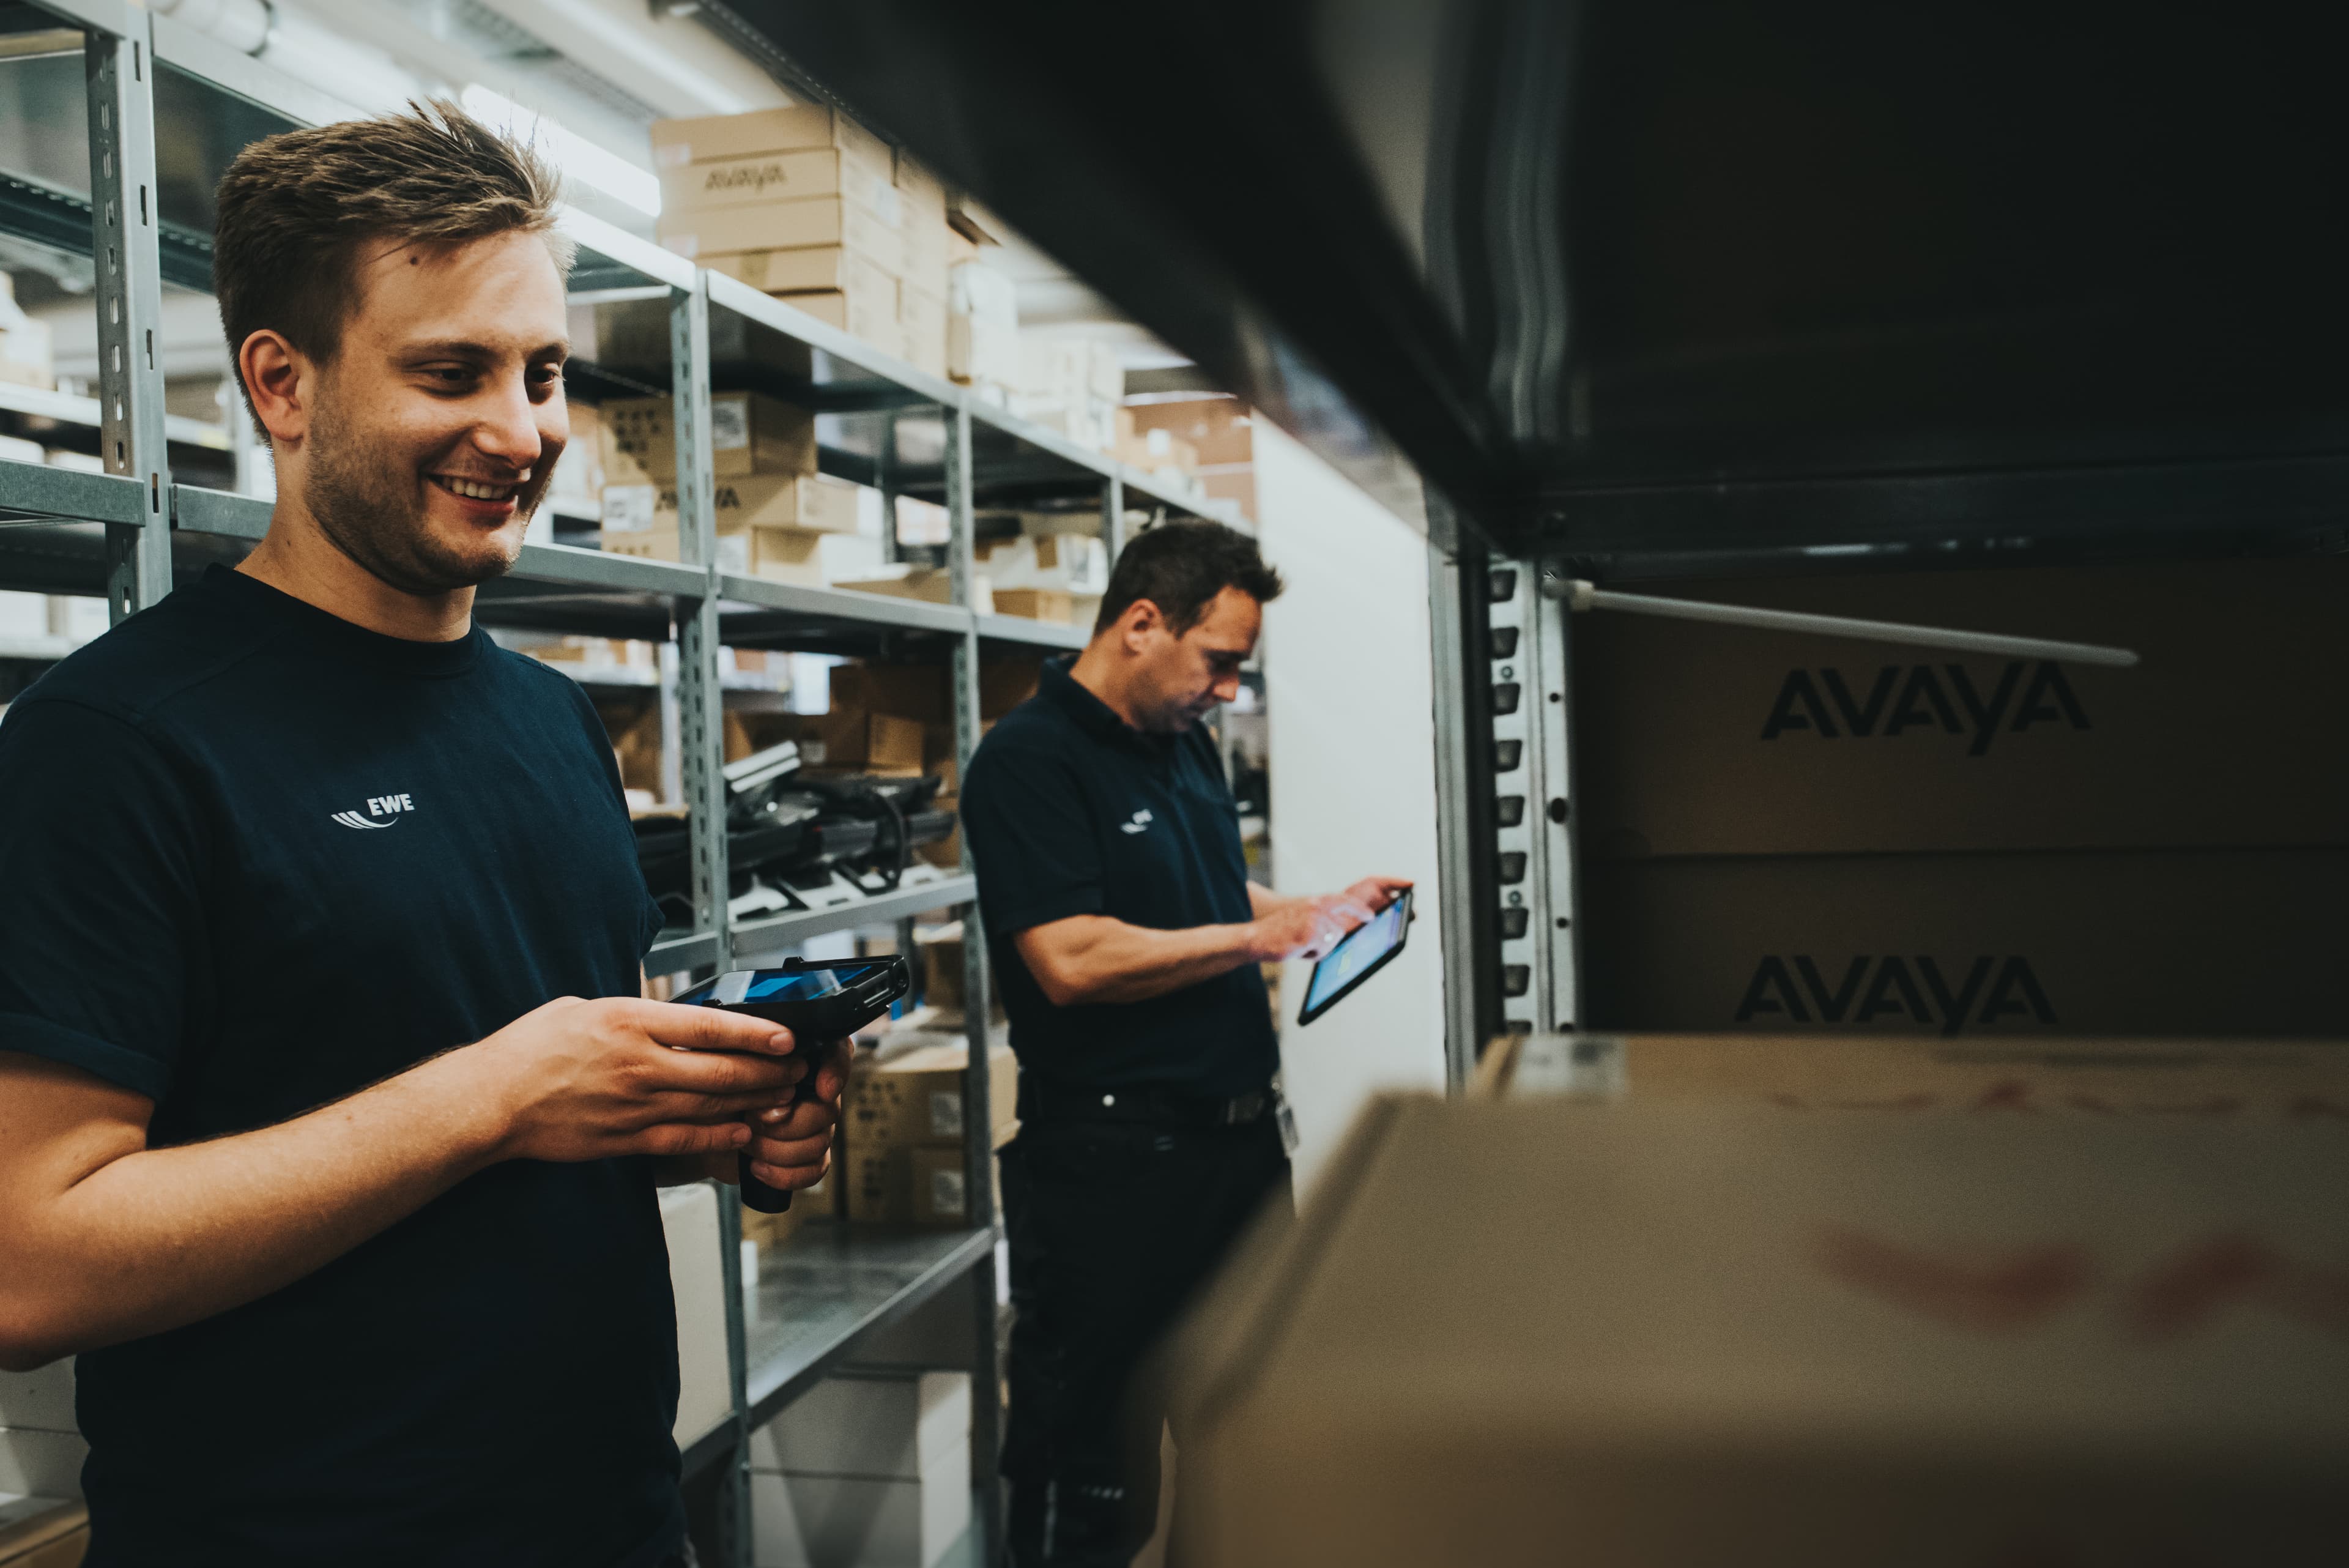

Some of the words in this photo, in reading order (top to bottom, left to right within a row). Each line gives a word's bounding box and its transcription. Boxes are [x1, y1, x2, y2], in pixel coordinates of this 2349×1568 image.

[1760, 660, 2093, 757] AVAYA
[367, 793, 415, 816] EWE
[1734, 954, 2059, 1038] AVAYA
